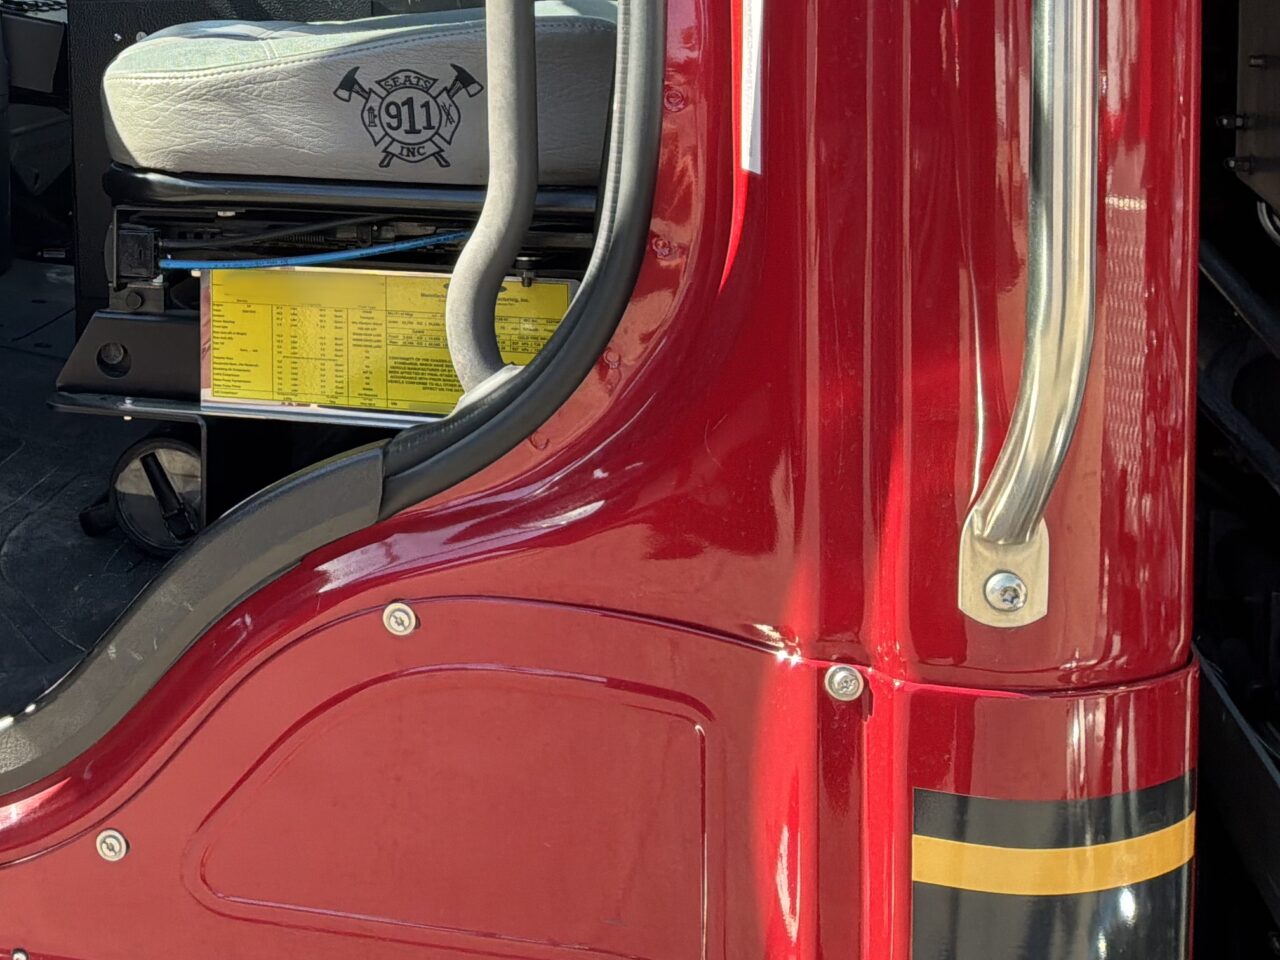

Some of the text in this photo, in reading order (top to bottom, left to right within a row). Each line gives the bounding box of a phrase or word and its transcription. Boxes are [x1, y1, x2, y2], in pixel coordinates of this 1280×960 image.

[384, 75, 432, 90] SEATS
[384, 96, 436, 134] 911
[398, 146, 426, 158] INC
